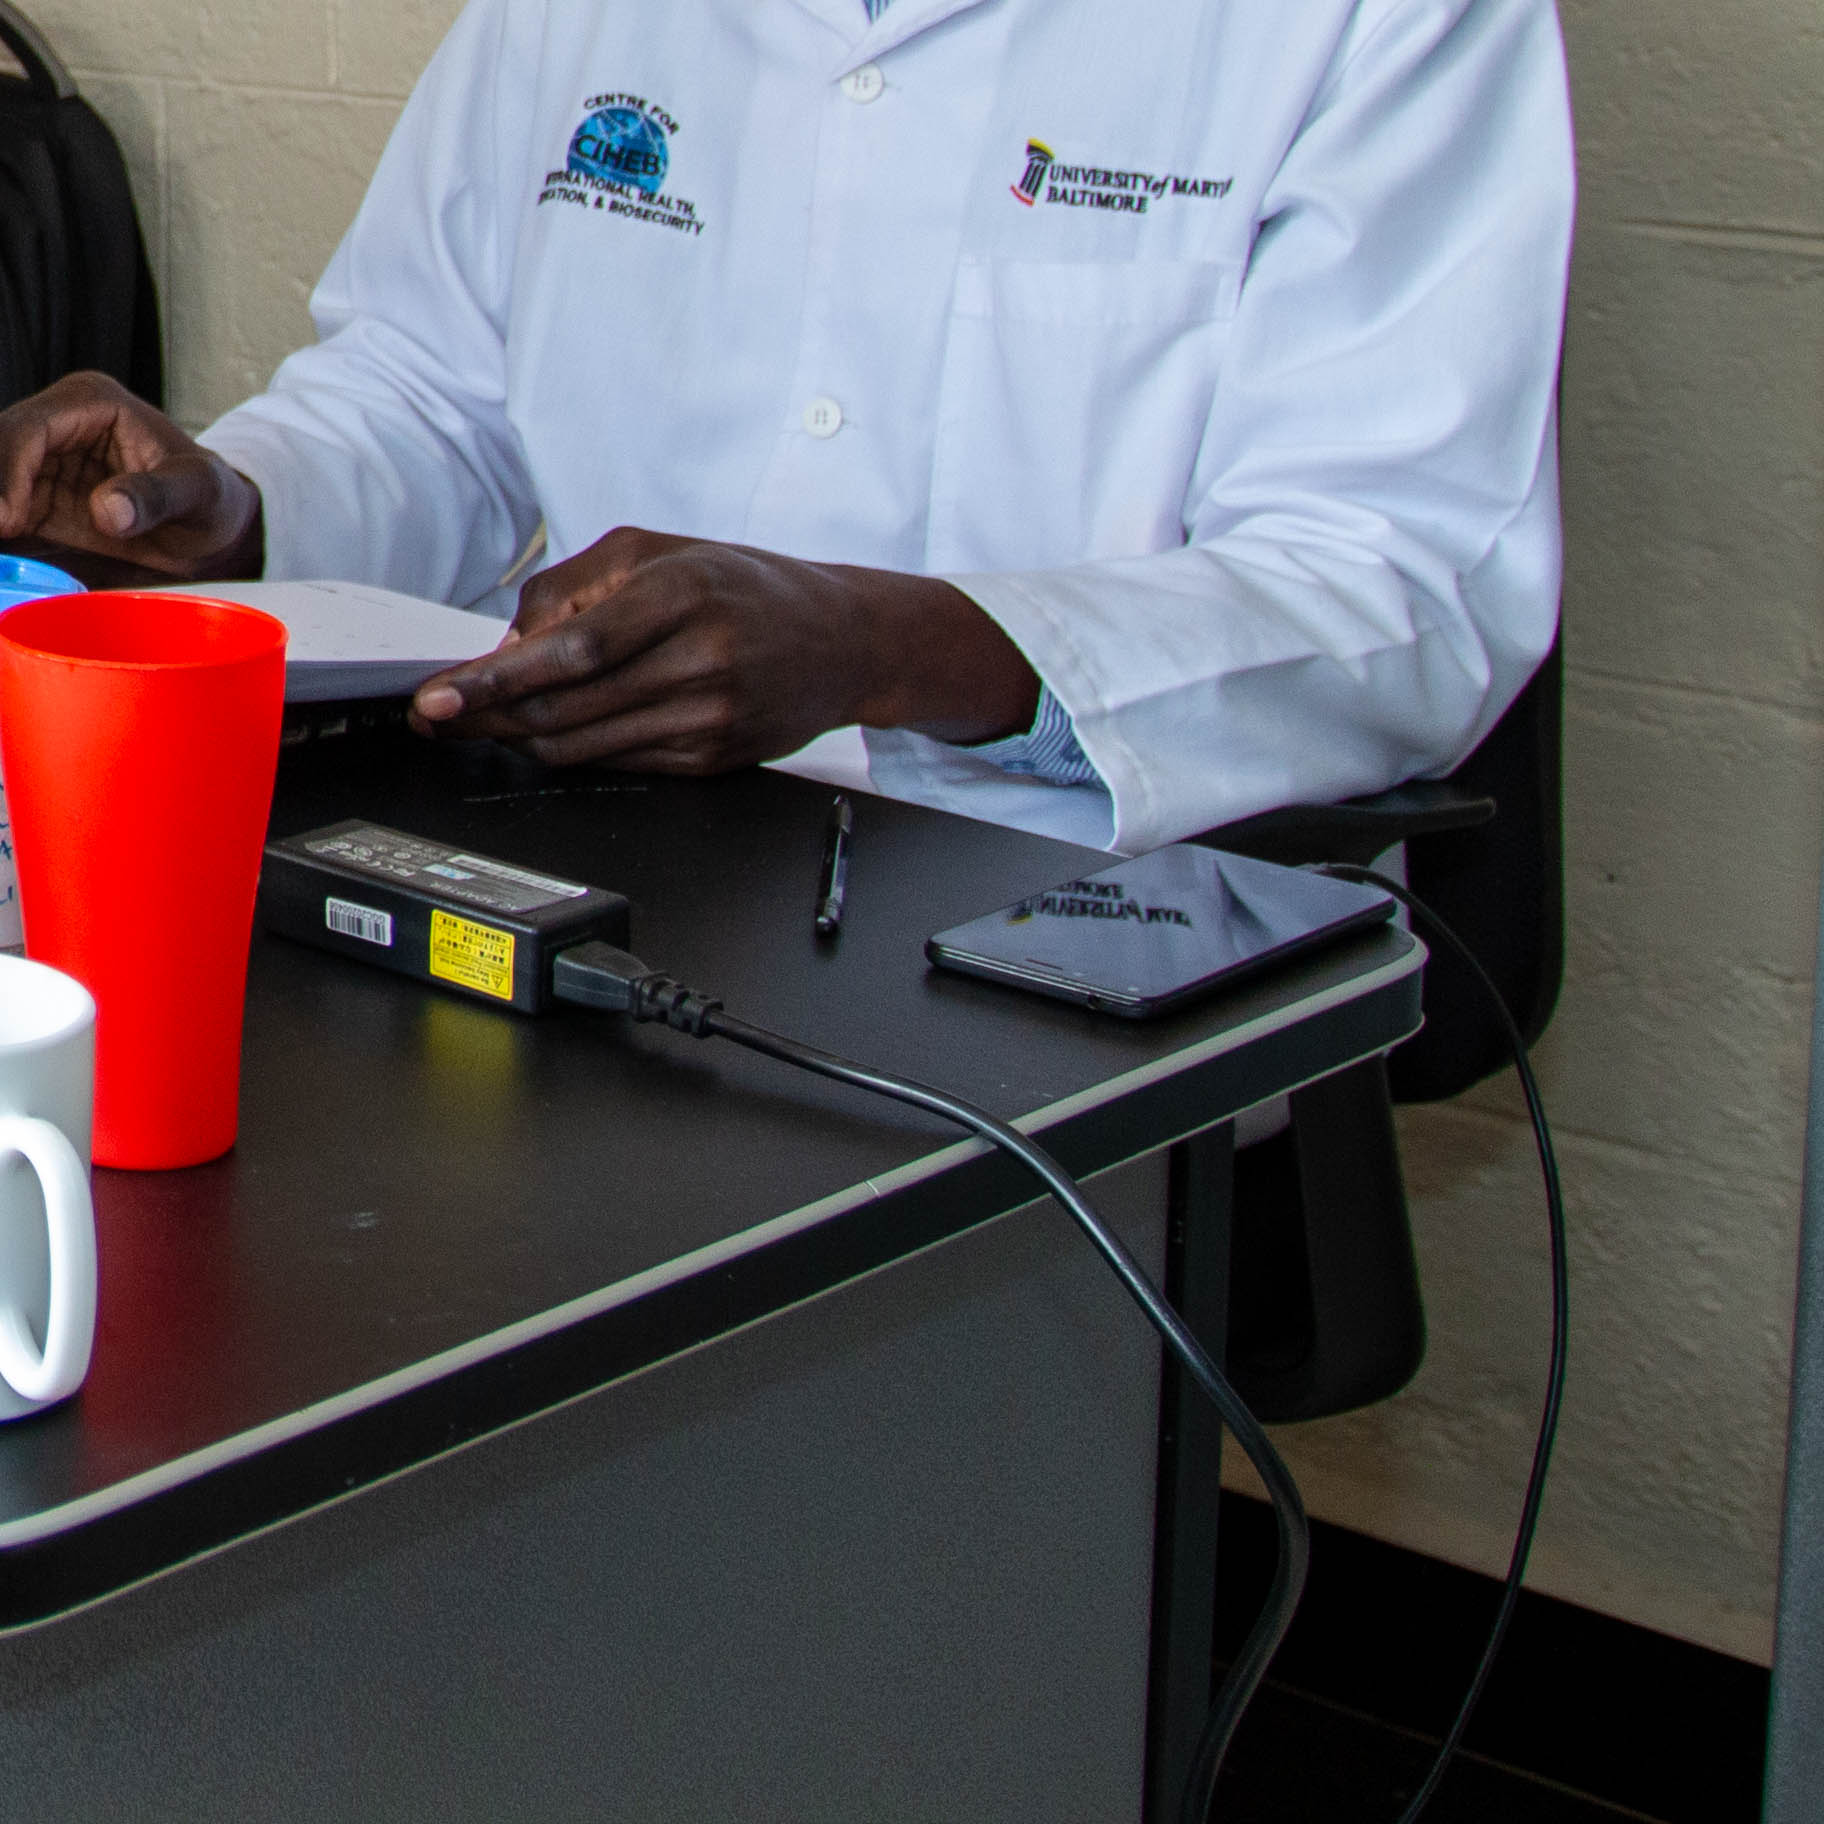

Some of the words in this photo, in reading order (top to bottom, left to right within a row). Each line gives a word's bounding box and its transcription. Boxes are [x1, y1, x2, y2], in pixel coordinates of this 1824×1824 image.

[583, 93, 648, 110] CENTRE
[650, 105, 680, 135] FOR
[575, 134, 661, 177] CIHEB
[1046, 185, 1148, 214] BALTIMORE
[1049, 164, 1153, 192] UNIVERSITY
[1151, 174, 1170, 200] of
[608, 199, 705, 237] BIOSECURITY
